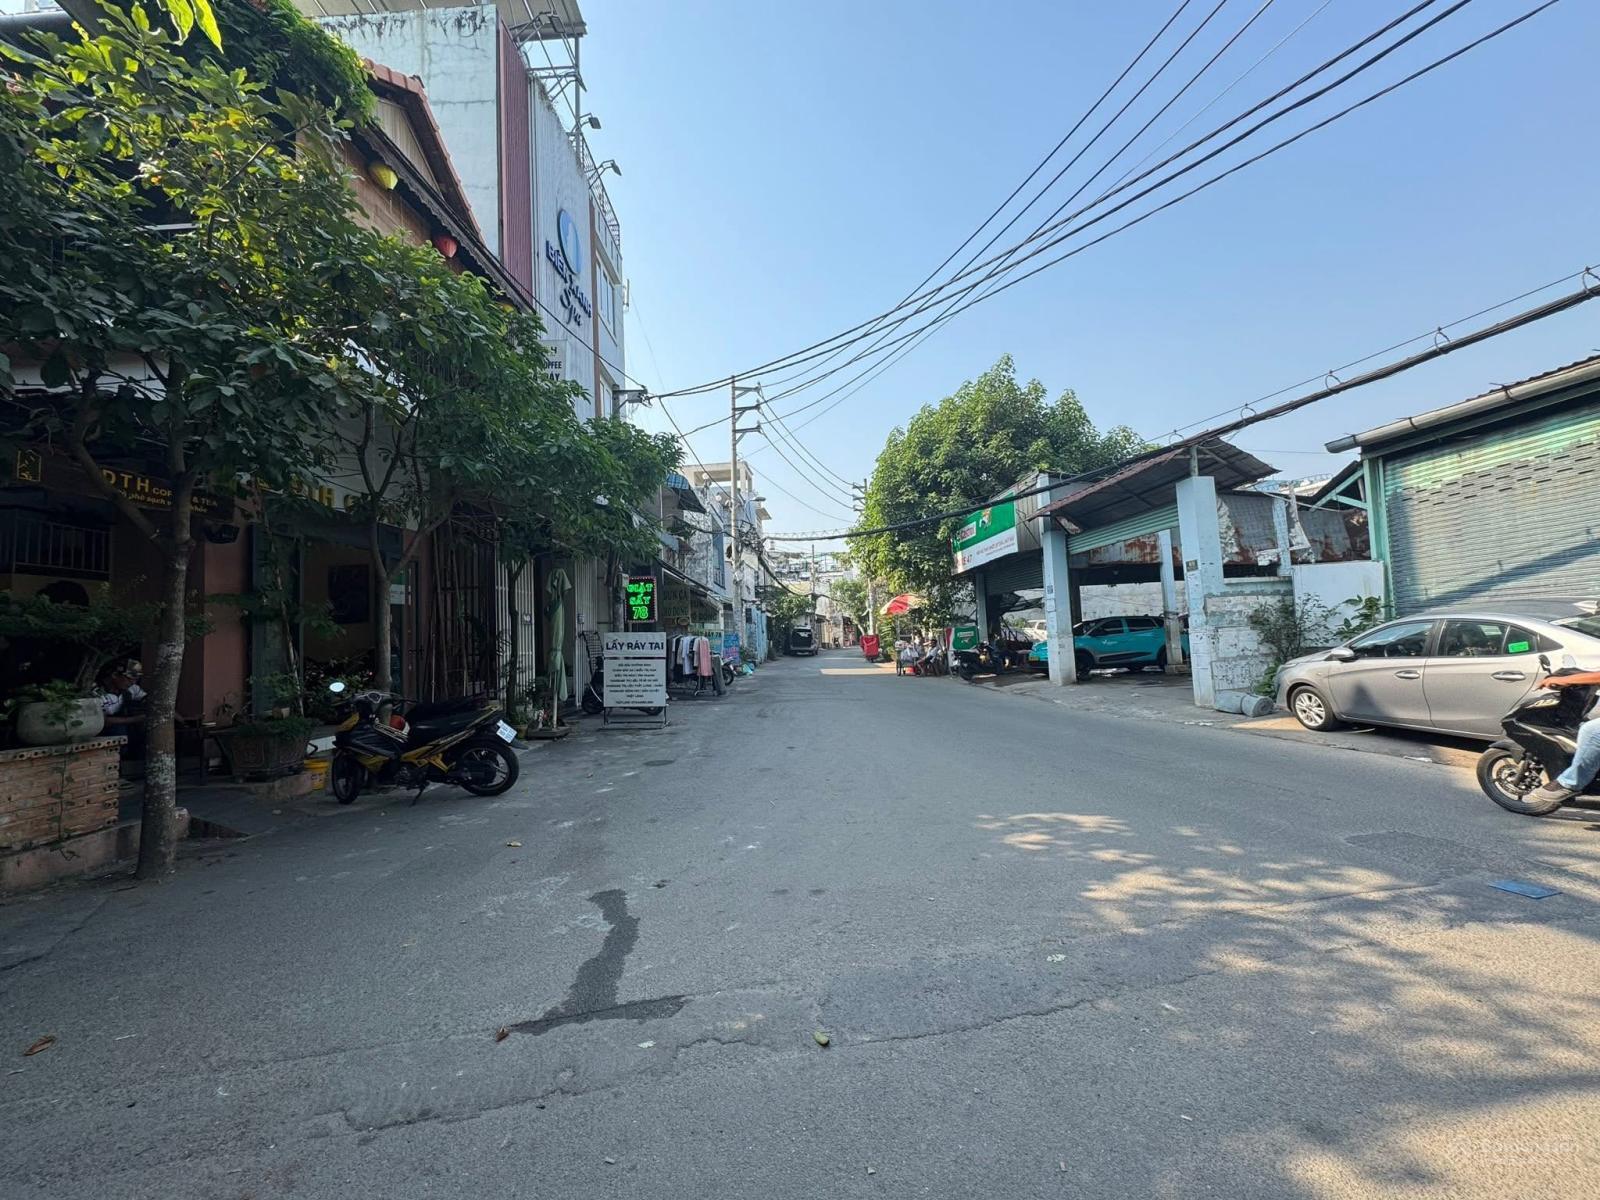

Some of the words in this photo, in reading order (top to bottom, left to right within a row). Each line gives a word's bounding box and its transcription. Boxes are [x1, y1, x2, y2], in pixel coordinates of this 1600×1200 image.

[545, 360, 562, 369] OFFEE
[632, 606, 649, 620] 78
[606, 638, 625, 651] LẤY
[626, 640, 646, 651] RÁY
[647, 641, 664, 651] TAI
